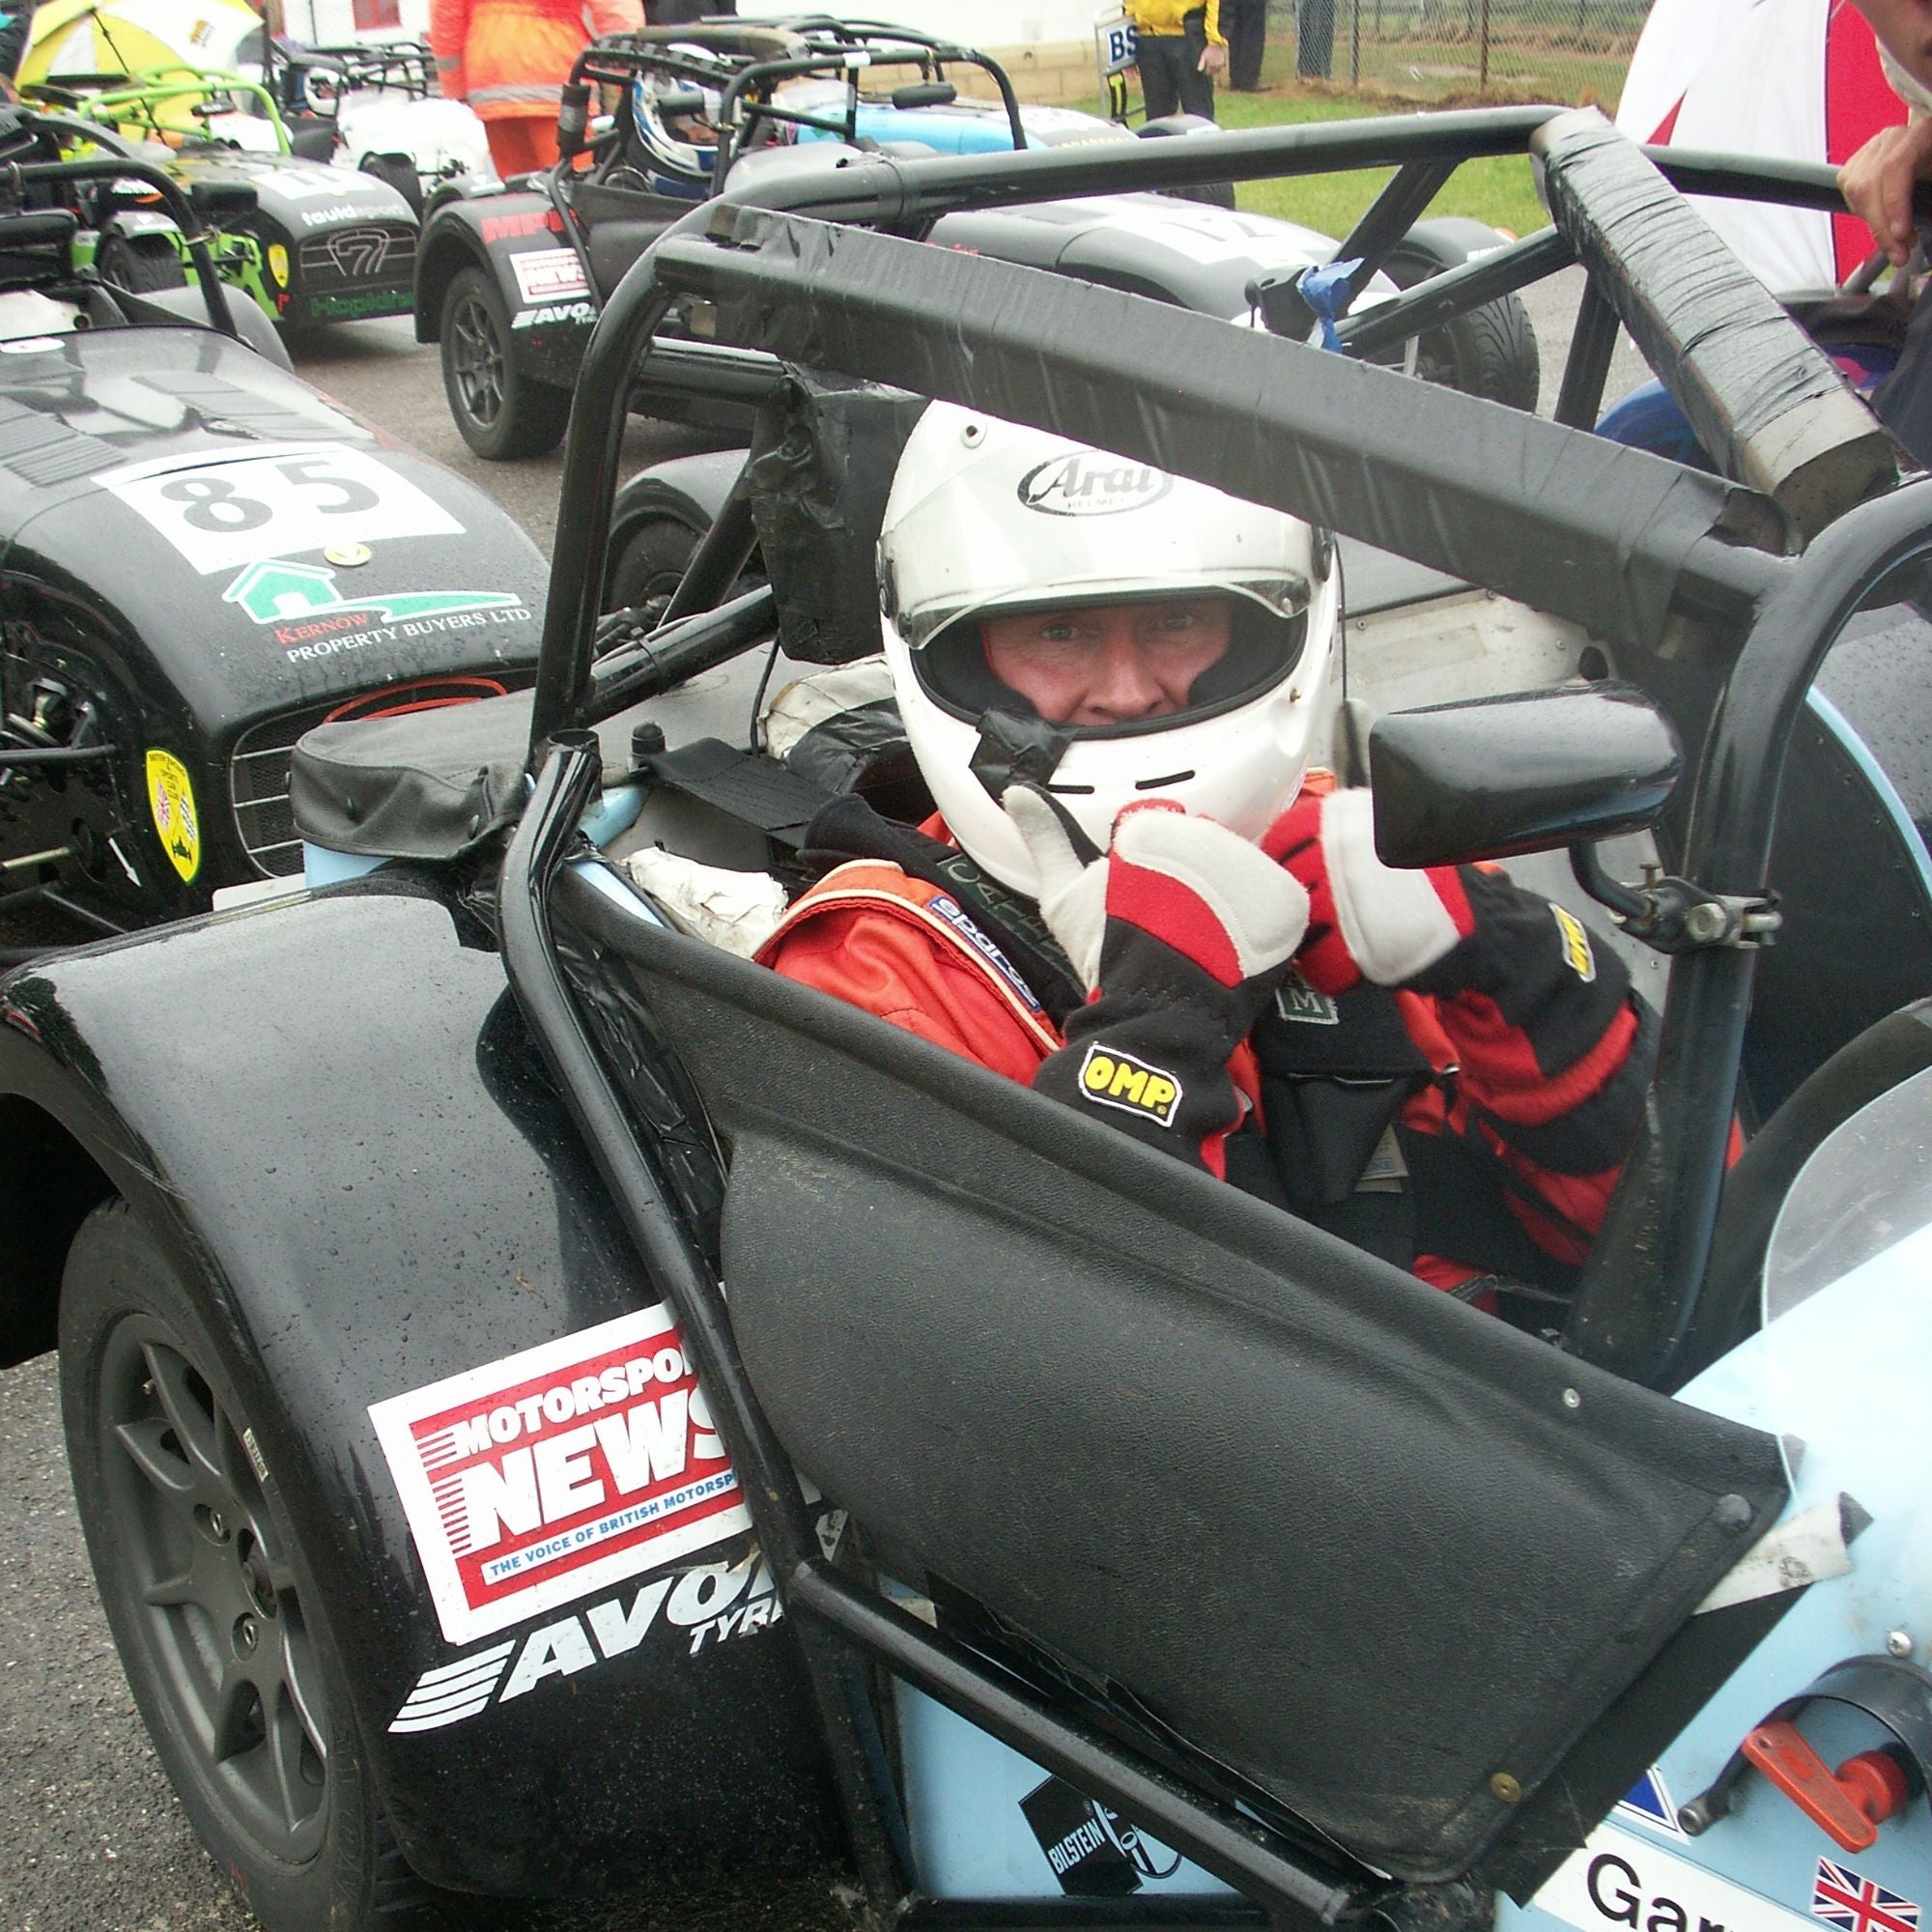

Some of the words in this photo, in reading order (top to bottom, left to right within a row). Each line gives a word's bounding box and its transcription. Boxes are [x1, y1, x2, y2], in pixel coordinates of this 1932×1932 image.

[160, 460, 381, 532] 85
[1028, 457, 1156, 503] Arai
[273, 613, 369, 644] KERNOW
[287, 626, 399, 664] PROPERTY
[403, 612, 487, 638] BUYERS
[490, 608, 531, 623] LTD
[1084, 1056, 1177, 1108] OMP
[490, 1556, 522, 1577] THE
[525, 1537, 571, 1562] VOICE
[576, 1522, 594, 1543] OF
[599, 1502, 660, 1533] BRITISH
[1046, 1818, 1106, 1875] BILSTEIN
